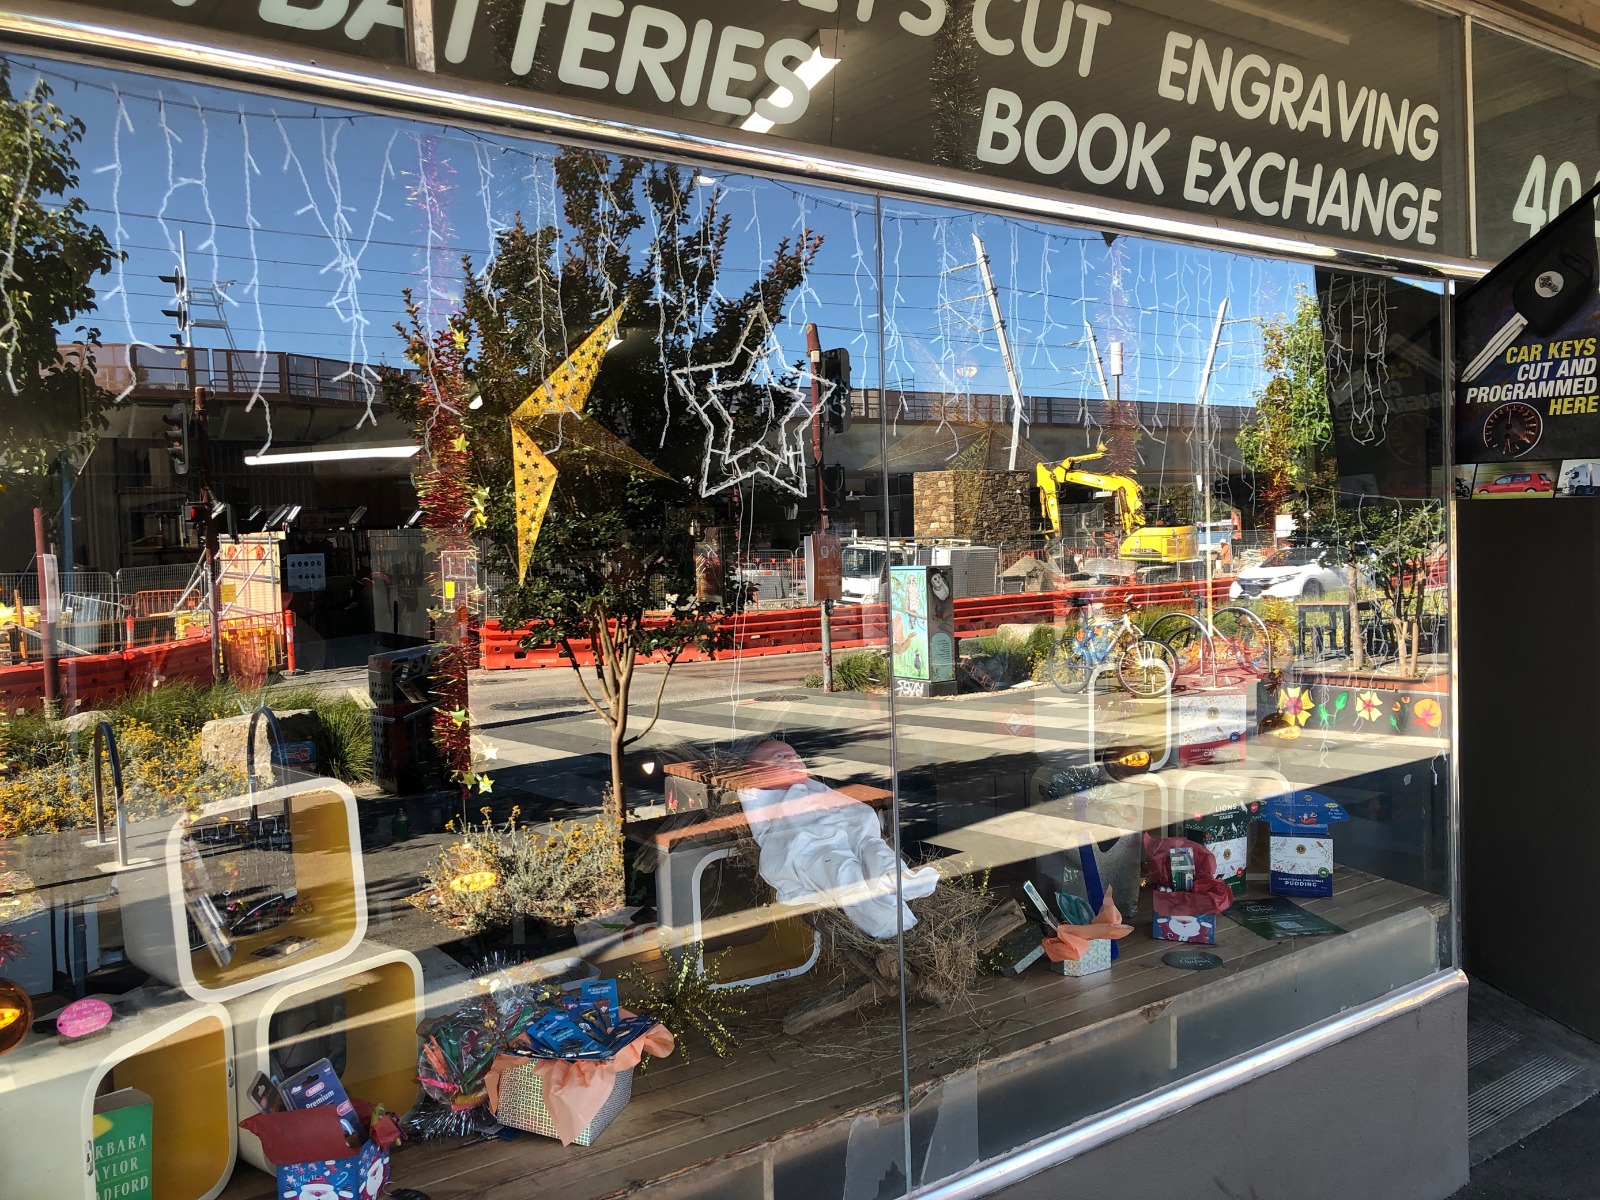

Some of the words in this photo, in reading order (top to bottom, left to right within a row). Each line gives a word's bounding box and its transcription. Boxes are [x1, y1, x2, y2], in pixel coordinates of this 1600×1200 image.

[972, 0, 1112, 78] CUT
[1158, 31, 1440, 162] ENGRAVING
[976, 87, 1171, 196] BOOK
[1183, 135, 1442, 246] EXCHANGE
[1512, 154, 1600, 239] 40
[1506, 344, 1544, 364] CAR
[1548, 337, 1598, 360] KEYS
[1517, 361, 1554, 382] CUT
[1555, 357, 1598, 378] AND
[1465, 376, 1598, 404] PROGRAMMED
[1548, 395, 1600, 416] HERE
[323, 515, 347, 525] Insol
[1215, 803, 1237, 812] LIONS
[305, 1090, 335, 1109] Premium
[94, 1133, 147, 1161] RBARA
[94, 1157, 139, 1182] AYLOR
[96, 1176, 149, 1200] DFORD
